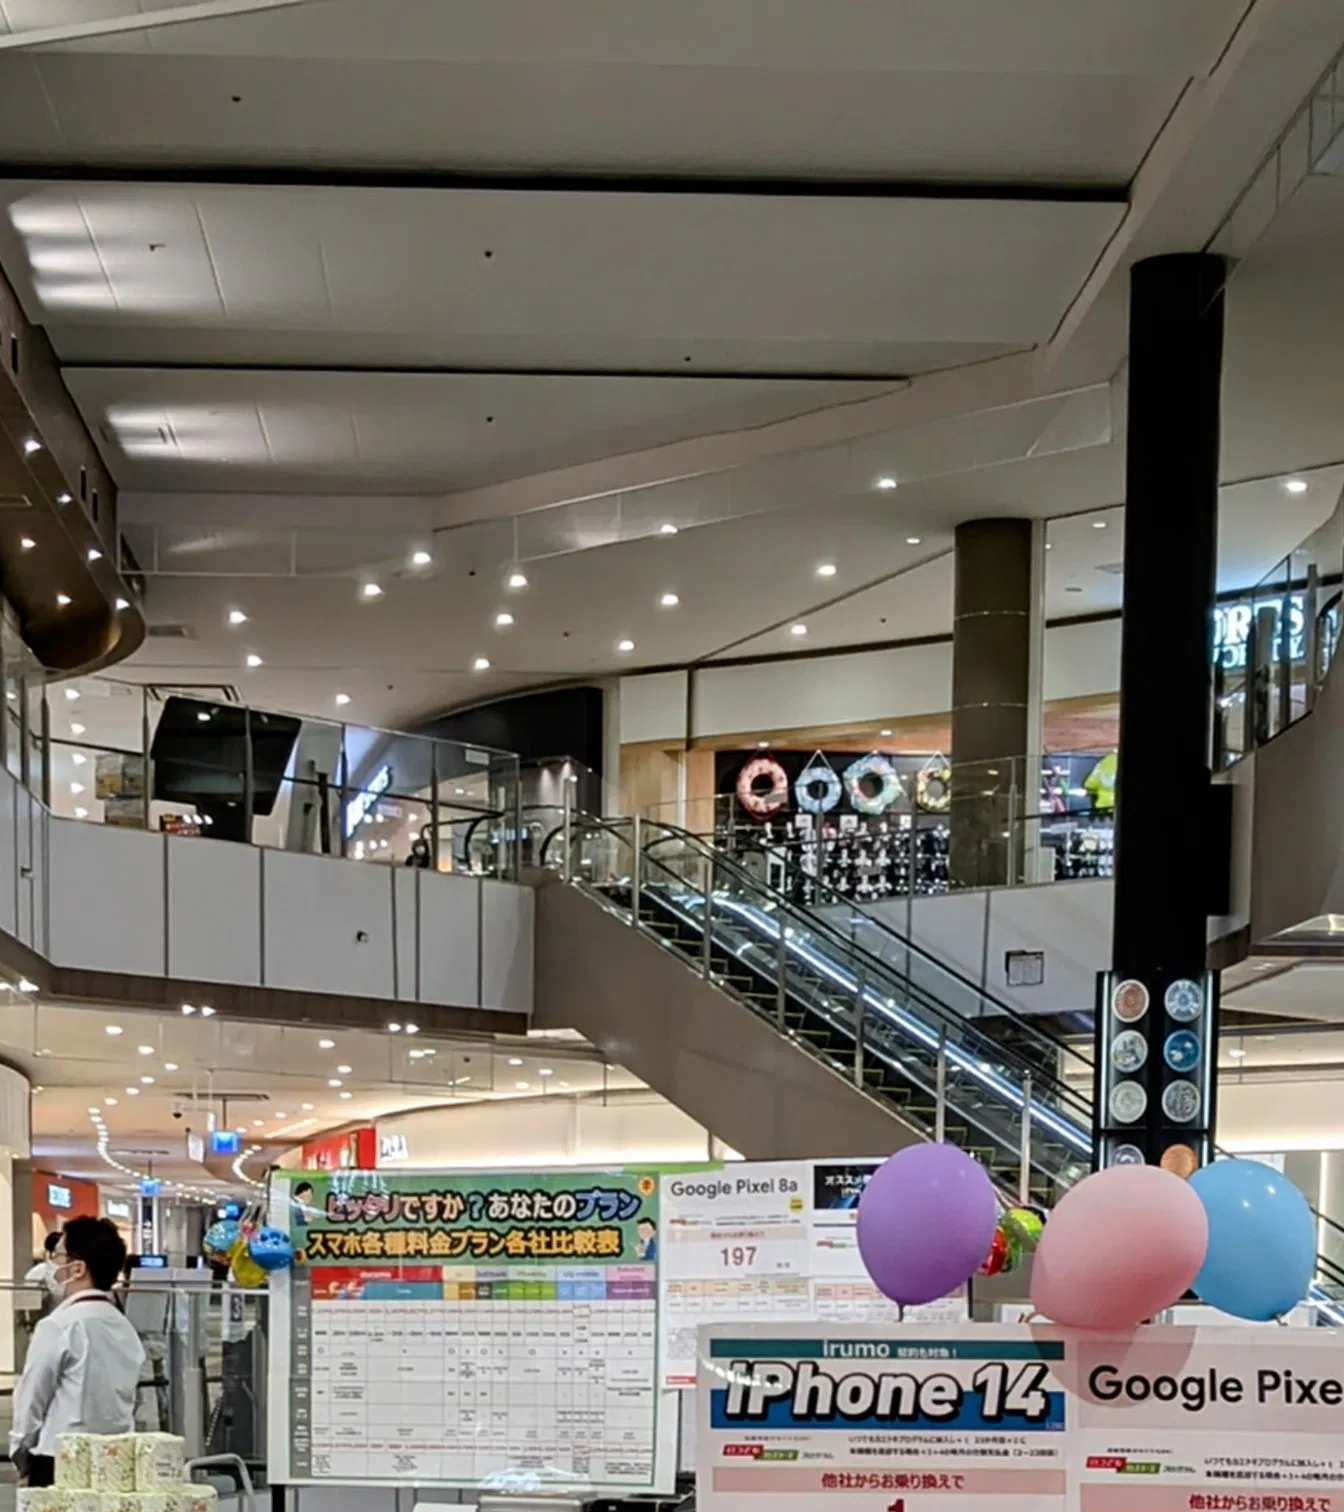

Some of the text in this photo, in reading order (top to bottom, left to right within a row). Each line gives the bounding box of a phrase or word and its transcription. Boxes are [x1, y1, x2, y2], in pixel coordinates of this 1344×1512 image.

[671, 1179, 798, 1199] Google Pixel 8a
[308, 1227, 623, 1257] スマホ各種料金プラン各社比較表
[721, 1246, 757, 1267] 197
[823, 1340, 890, 1357] irumo
[973, 1362, 1050, 1419] 14
[1089, 1365, 1244, 1412] Google
[821, 1473, 965, 1489] 他社からお乗り換えで
[1189, 1494, 1331, 1512] 他社からお乗り換えで
